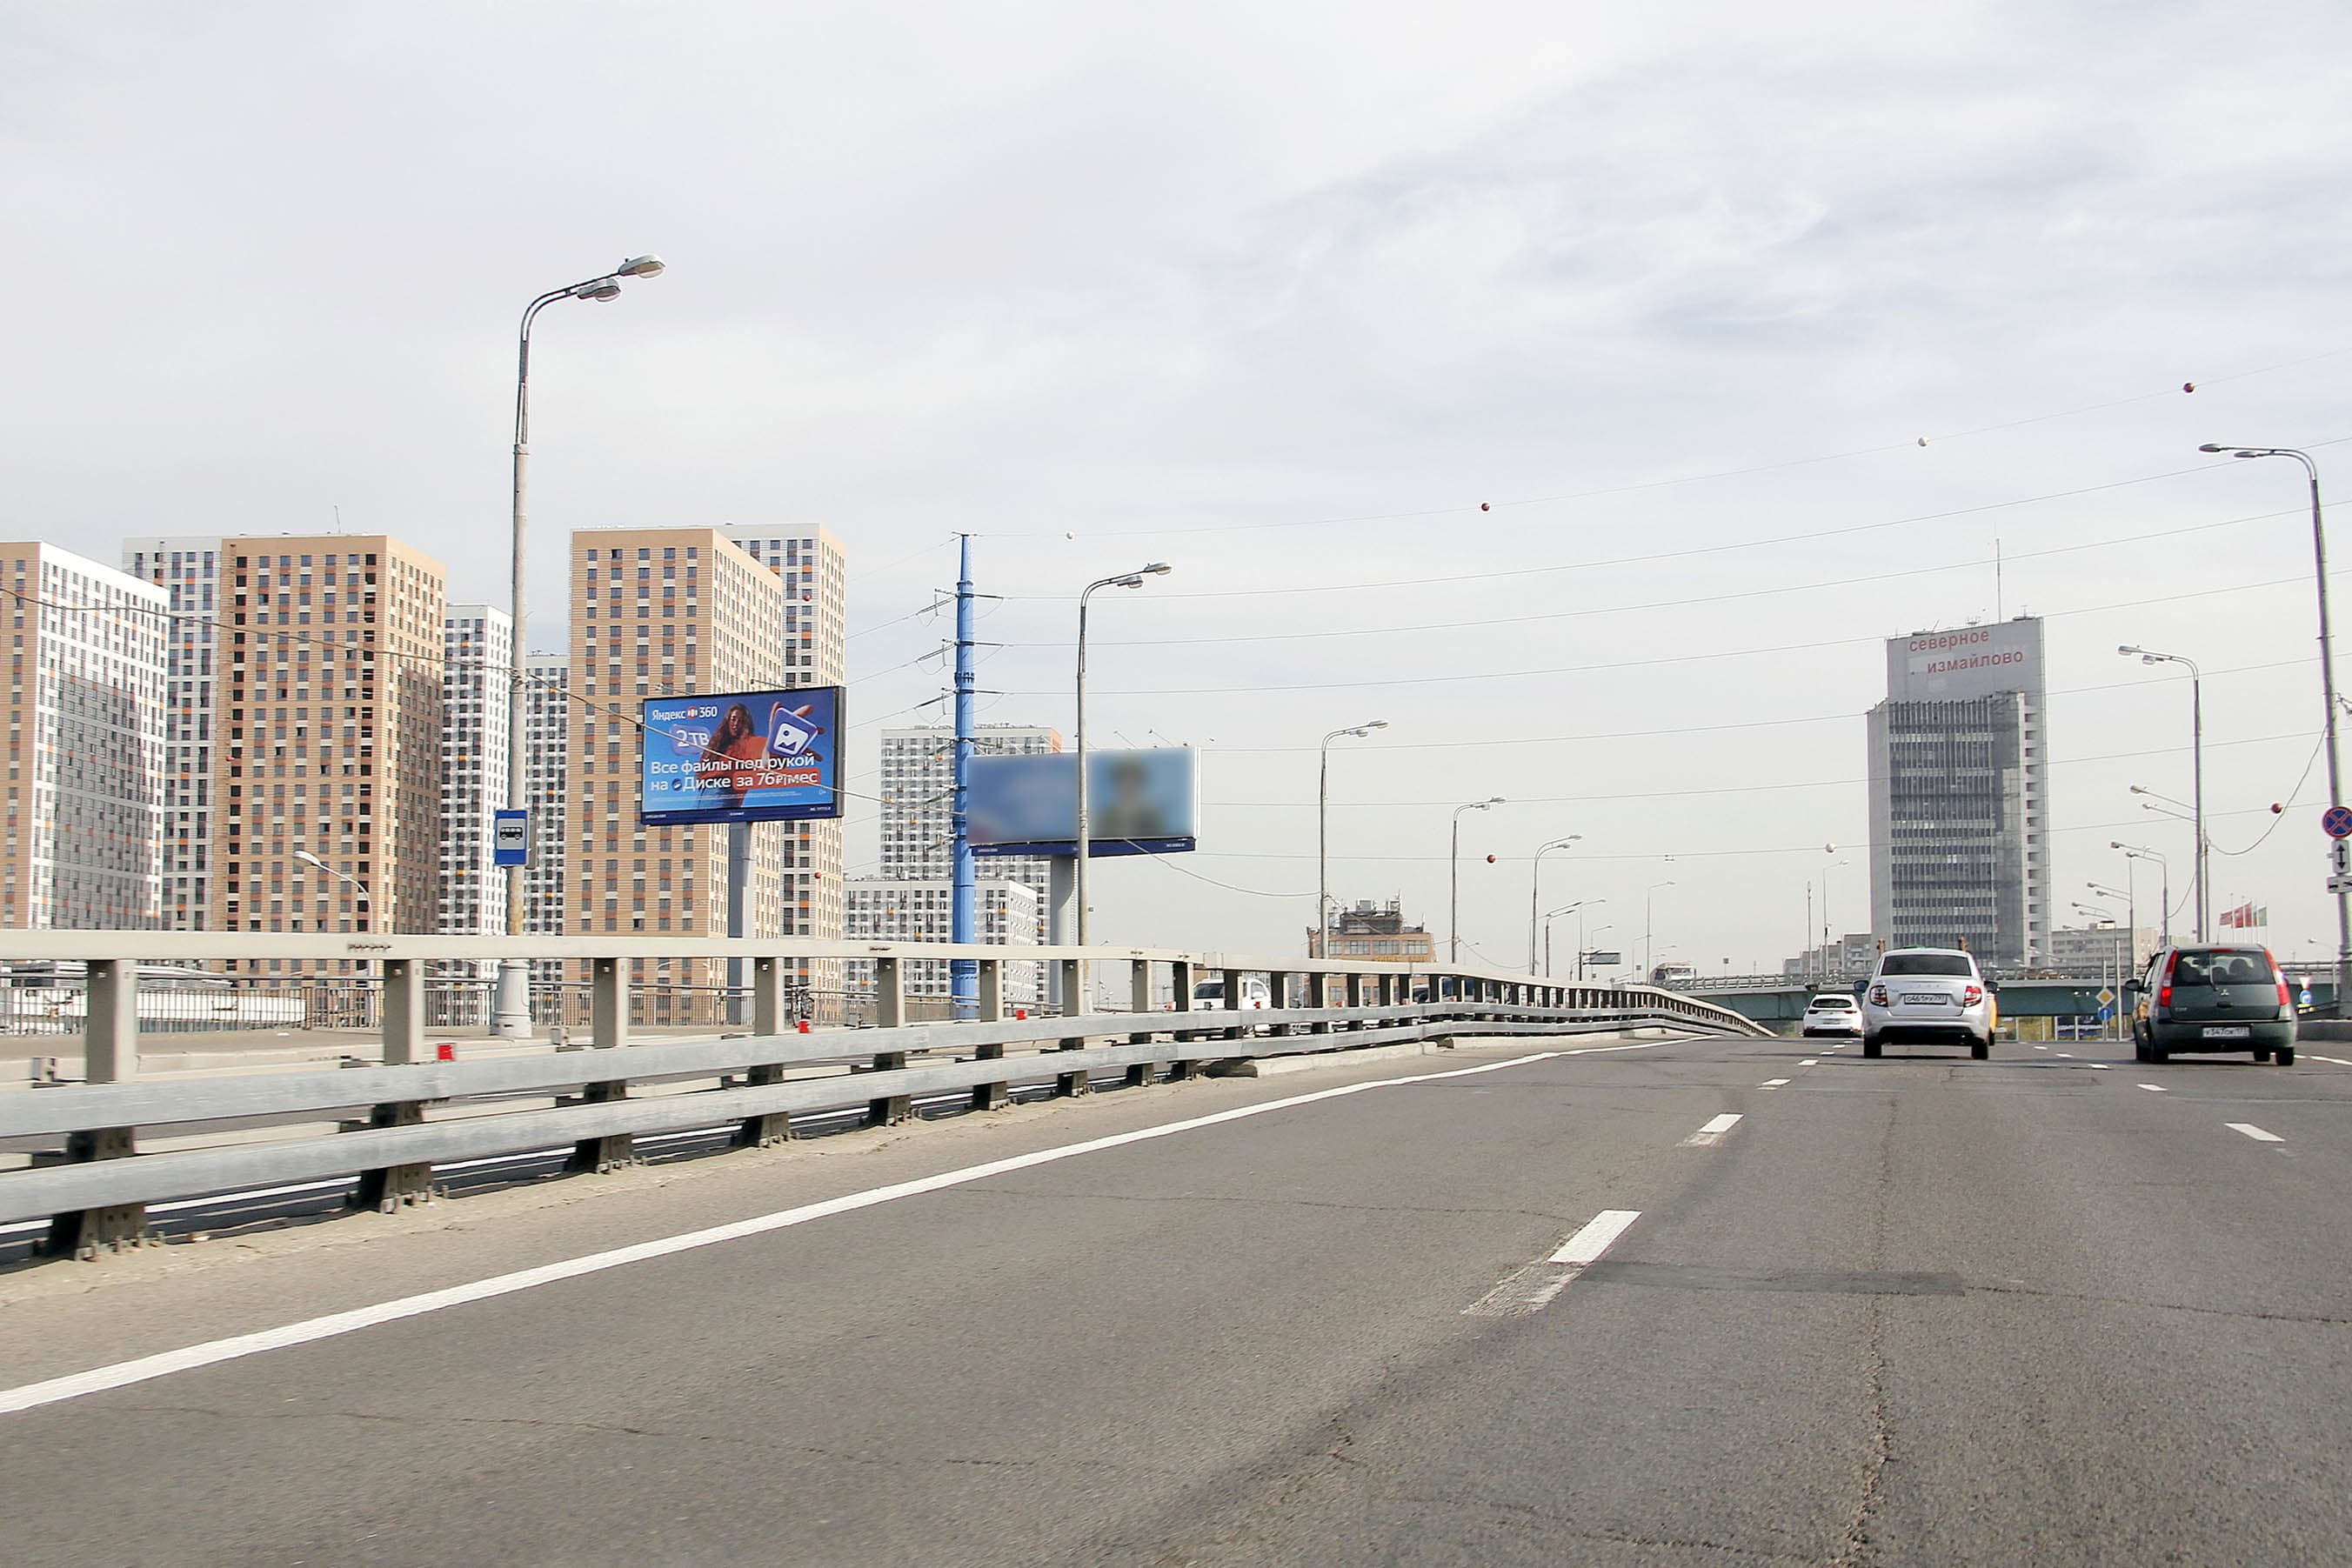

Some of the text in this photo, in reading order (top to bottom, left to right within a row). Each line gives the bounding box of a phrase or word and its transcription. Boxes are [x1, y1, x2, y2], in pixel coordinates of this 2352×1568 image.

[1909, 631, 1989, 652] северное
[1927, 651, 2023, 673] измайлово
[651, 706, 718, 721] Яндекс 360
[651, 761, 678, 775] Все
[681, 758, 732, 776] файлы
[767, 752, 815, 770] рукой
[651, 780, 669, 791] на
[682, 775, 732, 792] Диске
[736, 776, 754, 787] за
